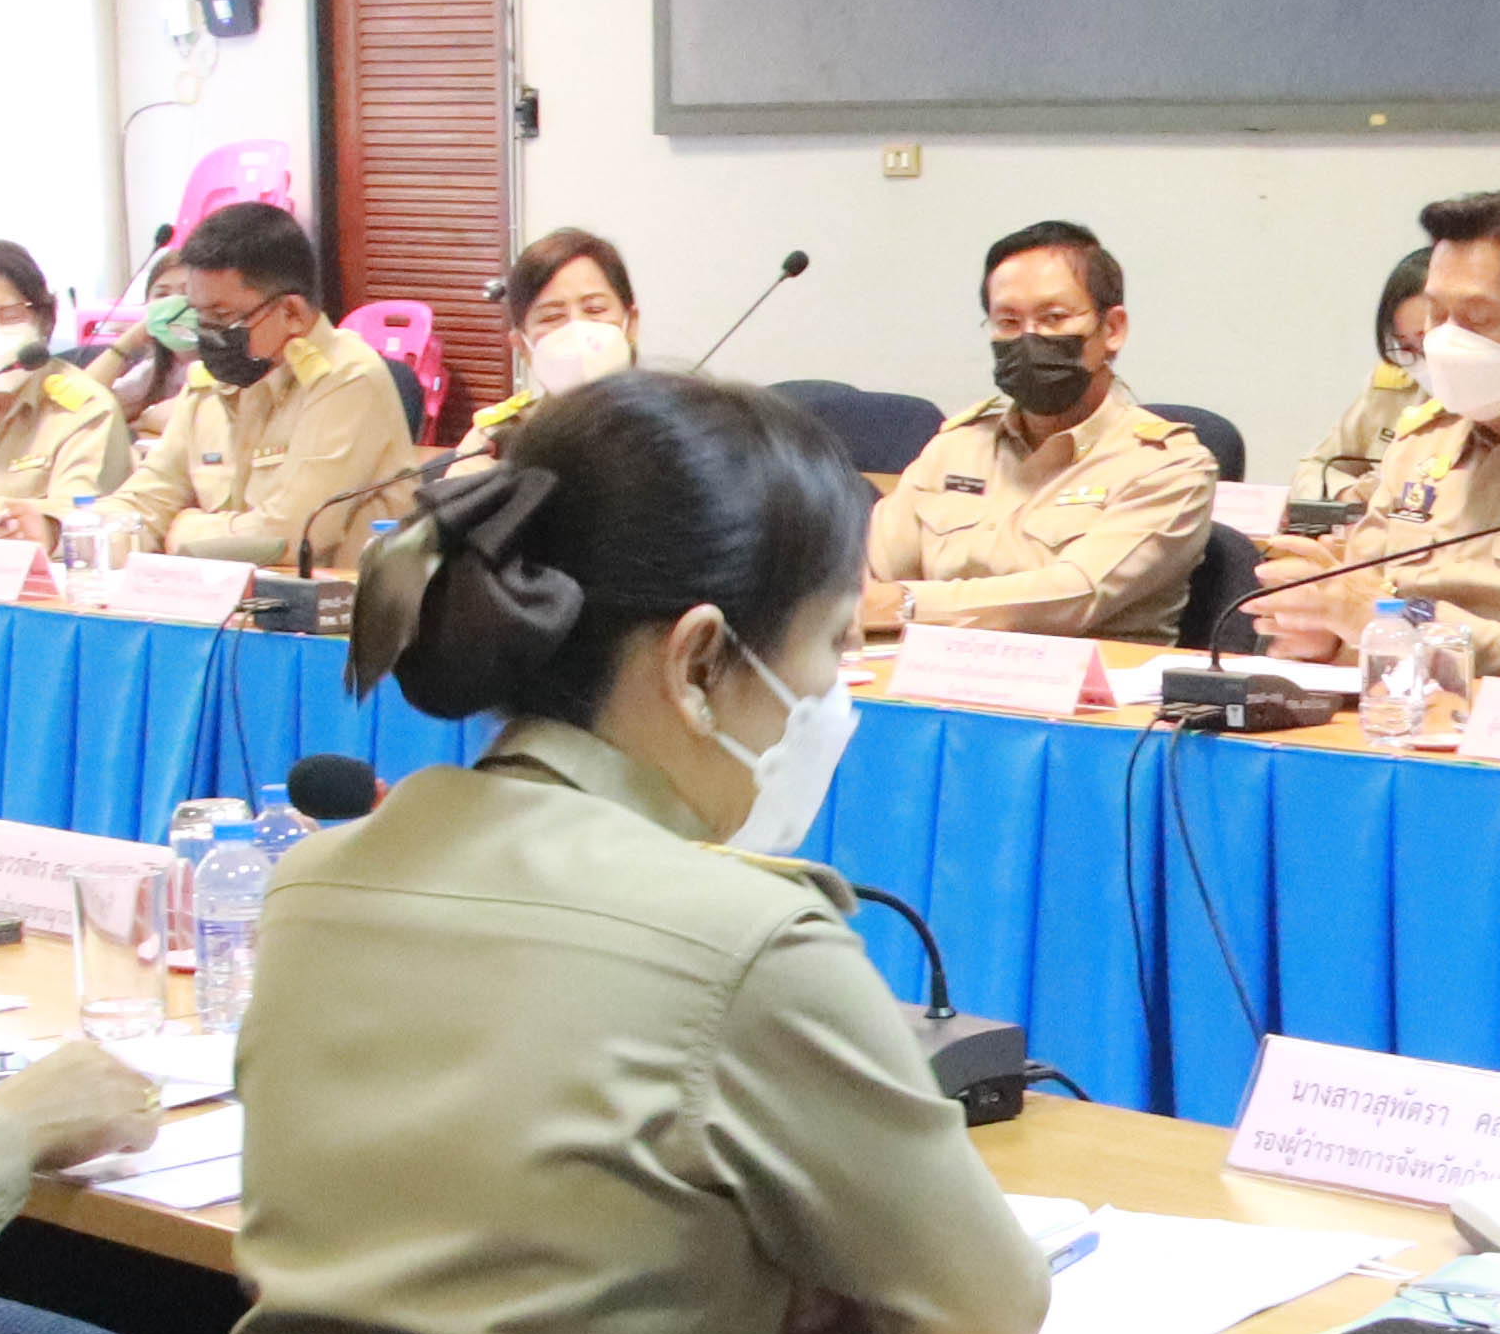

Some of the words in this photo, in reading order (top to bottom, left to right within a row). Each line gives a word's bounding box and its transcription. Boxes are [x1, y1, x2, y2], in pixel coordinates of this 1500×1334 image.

[1291, 1078, 1451, 1129] นางสาวสุพัตรา
